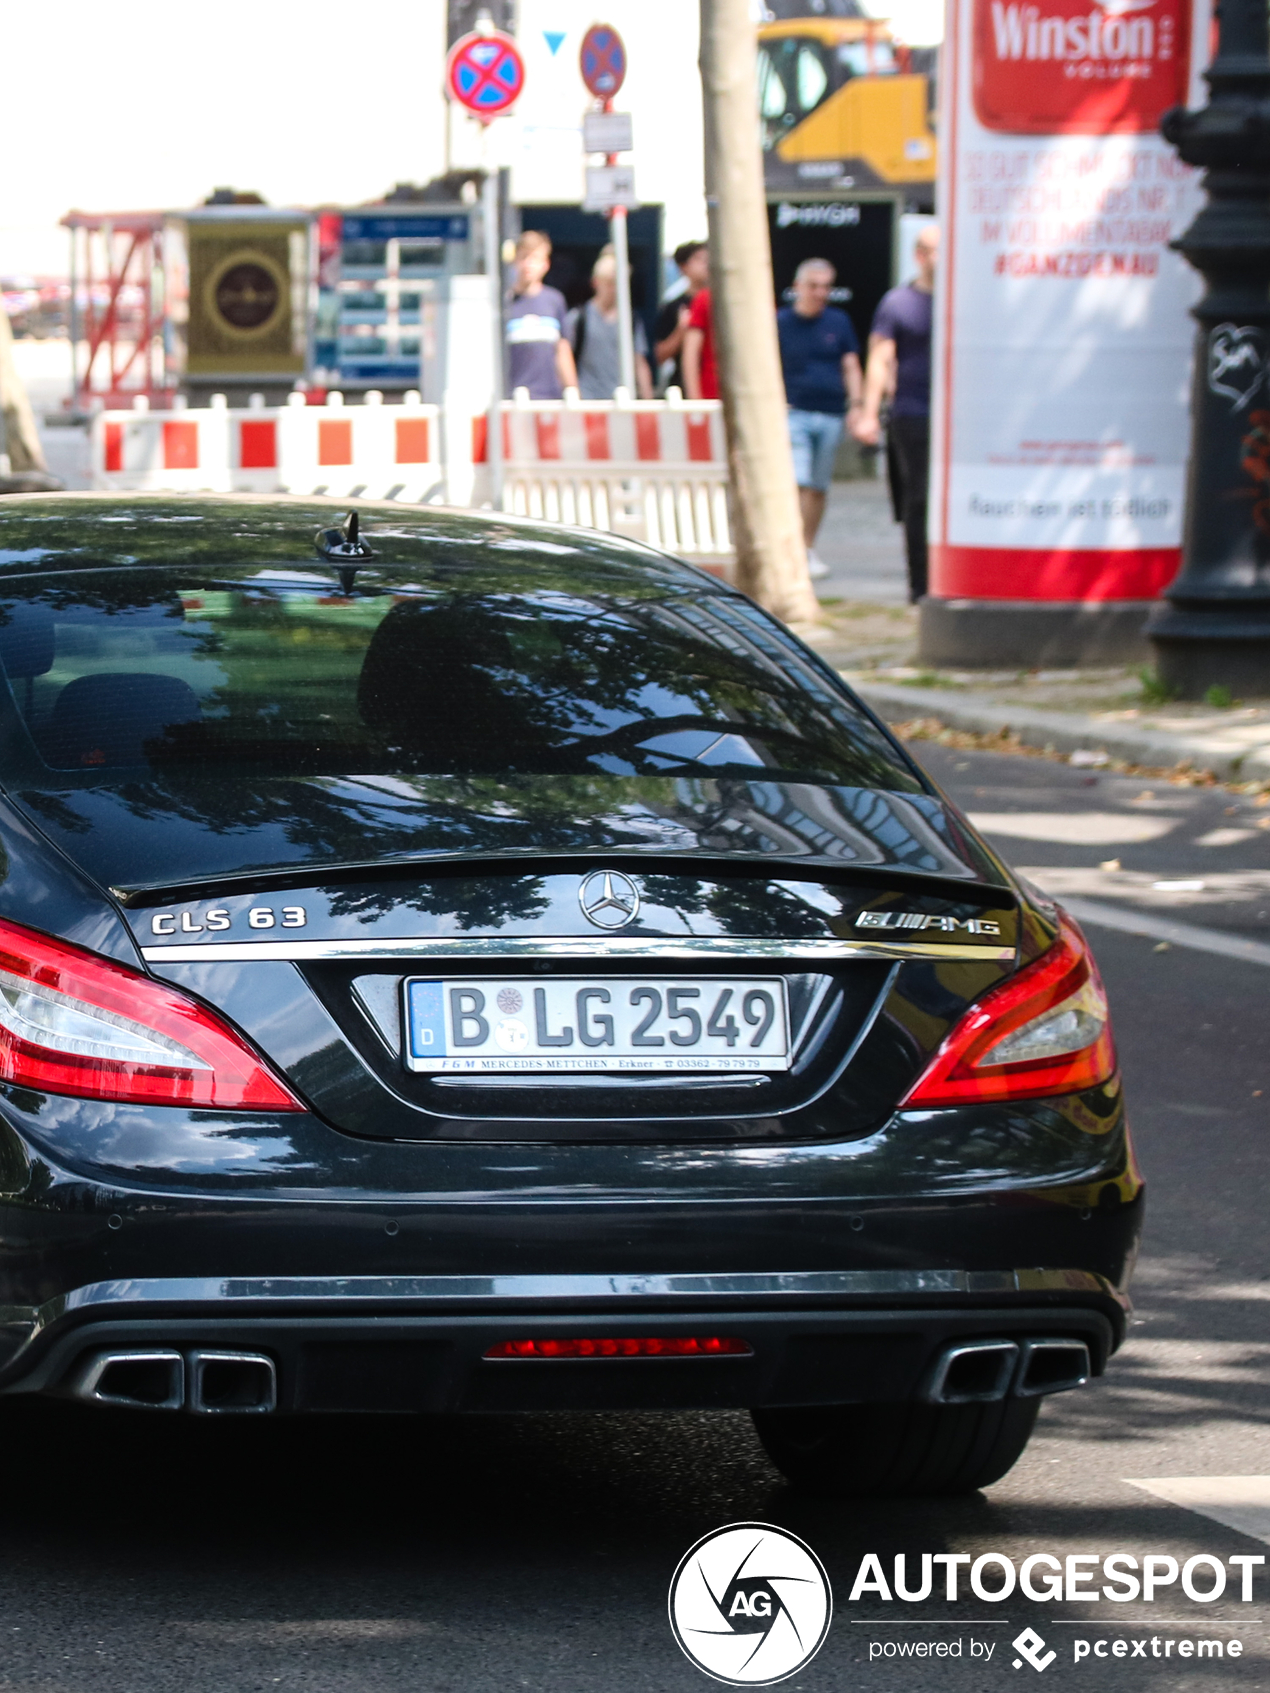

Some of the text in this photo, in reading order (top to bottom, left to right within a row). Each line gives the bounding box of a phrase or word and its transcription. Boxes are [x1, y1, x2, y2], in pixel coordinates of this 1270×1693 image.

[991, 0, 1154, 60] Winston
[152, 906, 307, 935] CLS 63
[420, 1028, 435, 1046] D
[450, 986, 775, 1047] B LG 2549
